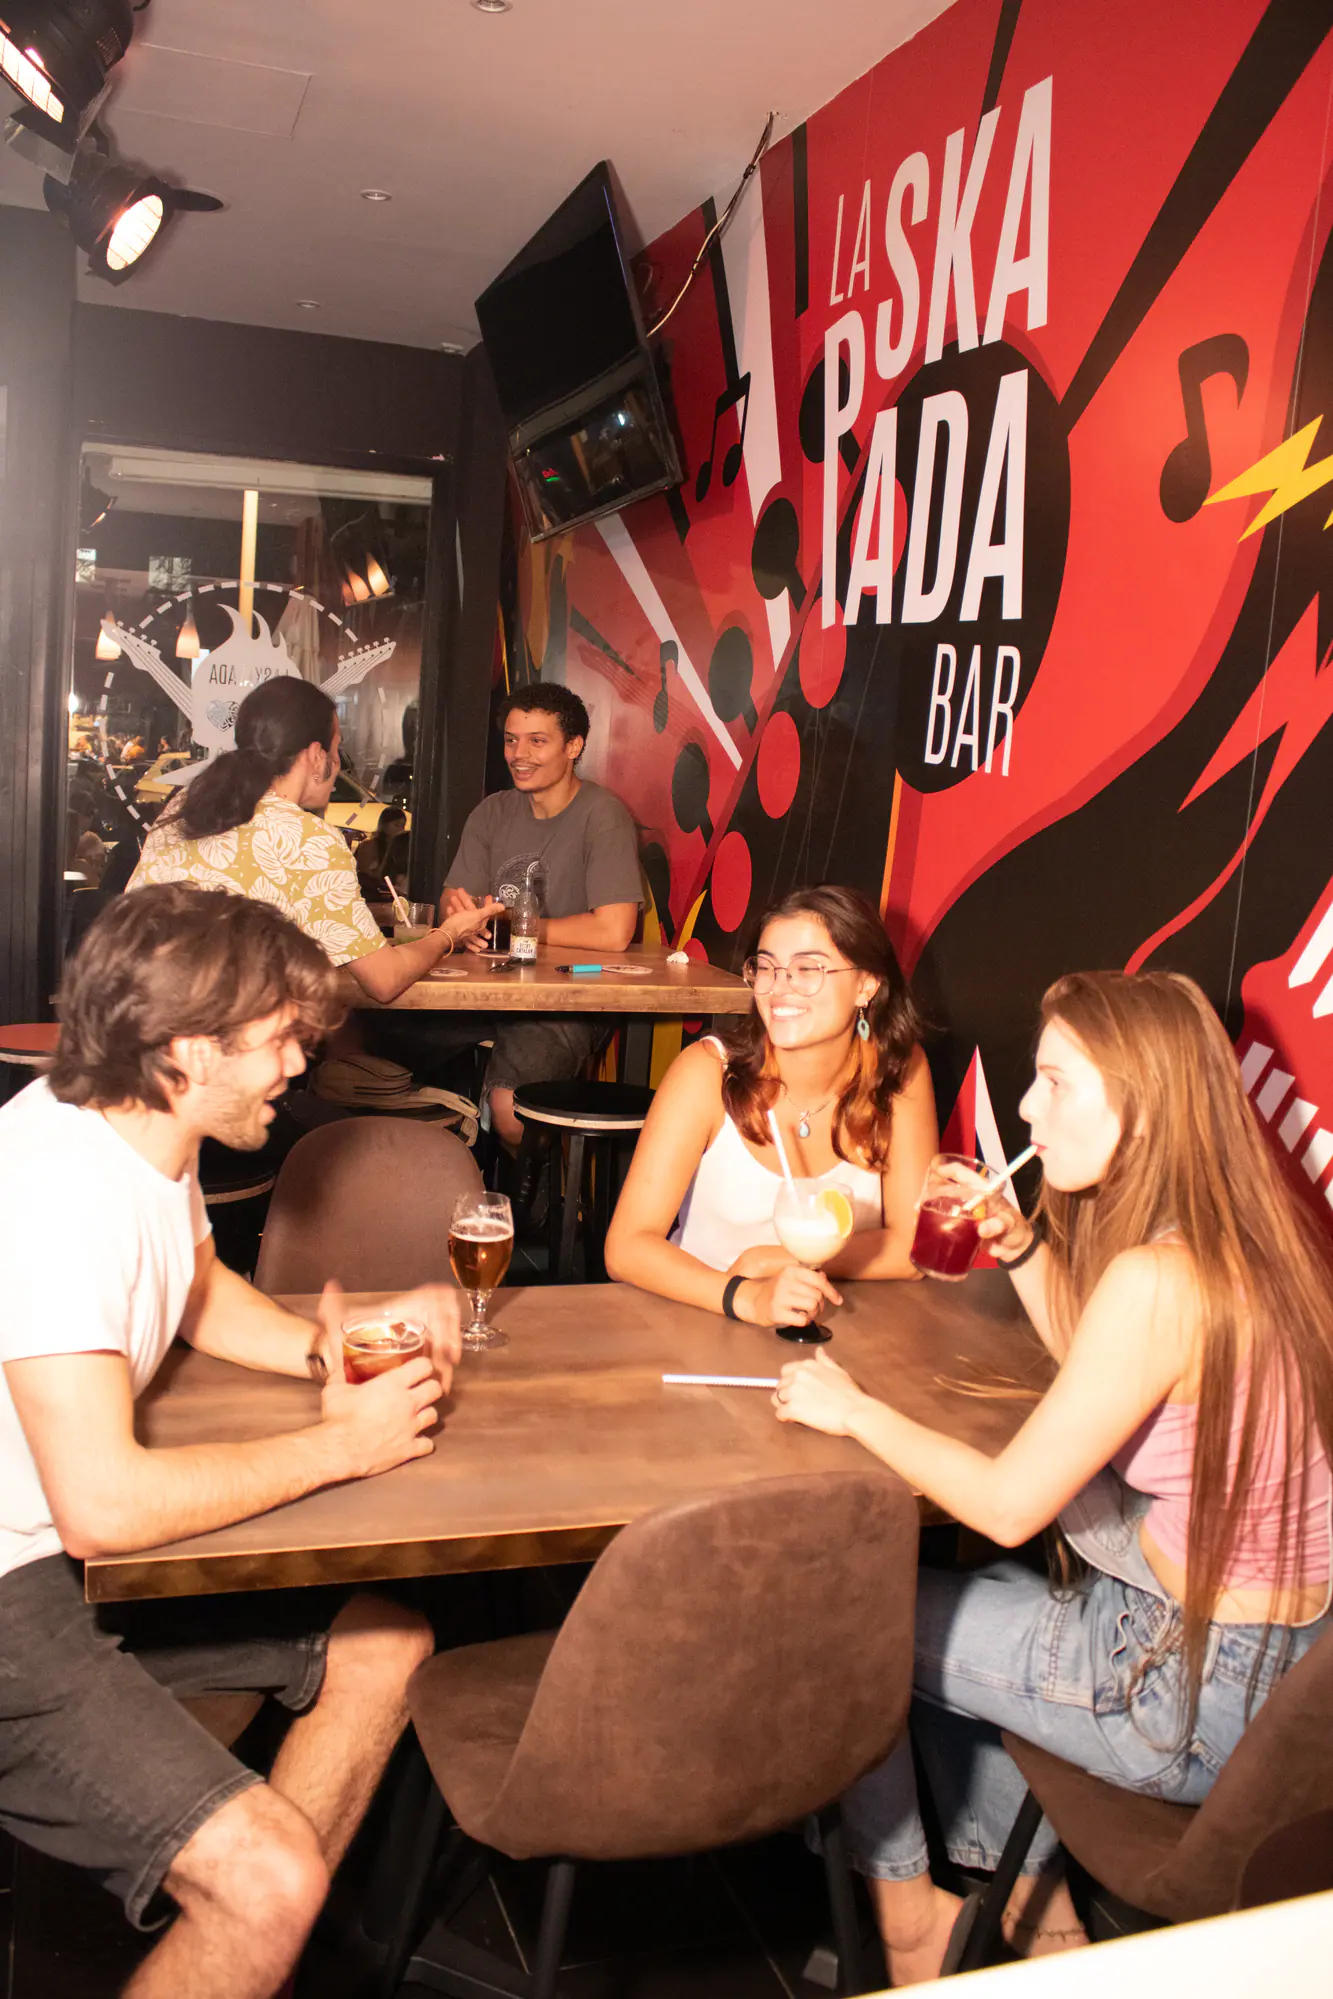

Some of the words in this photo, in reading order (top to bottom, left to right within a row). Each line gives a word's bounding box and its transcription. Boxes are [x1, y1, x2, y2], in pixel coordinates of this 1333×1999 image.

[829, 178, 871, 307] LA
[875, 74, 1053, 380] SKA
[821, 310, 1029, 630] PADA
[924, 643, 1021, 777] BAR
